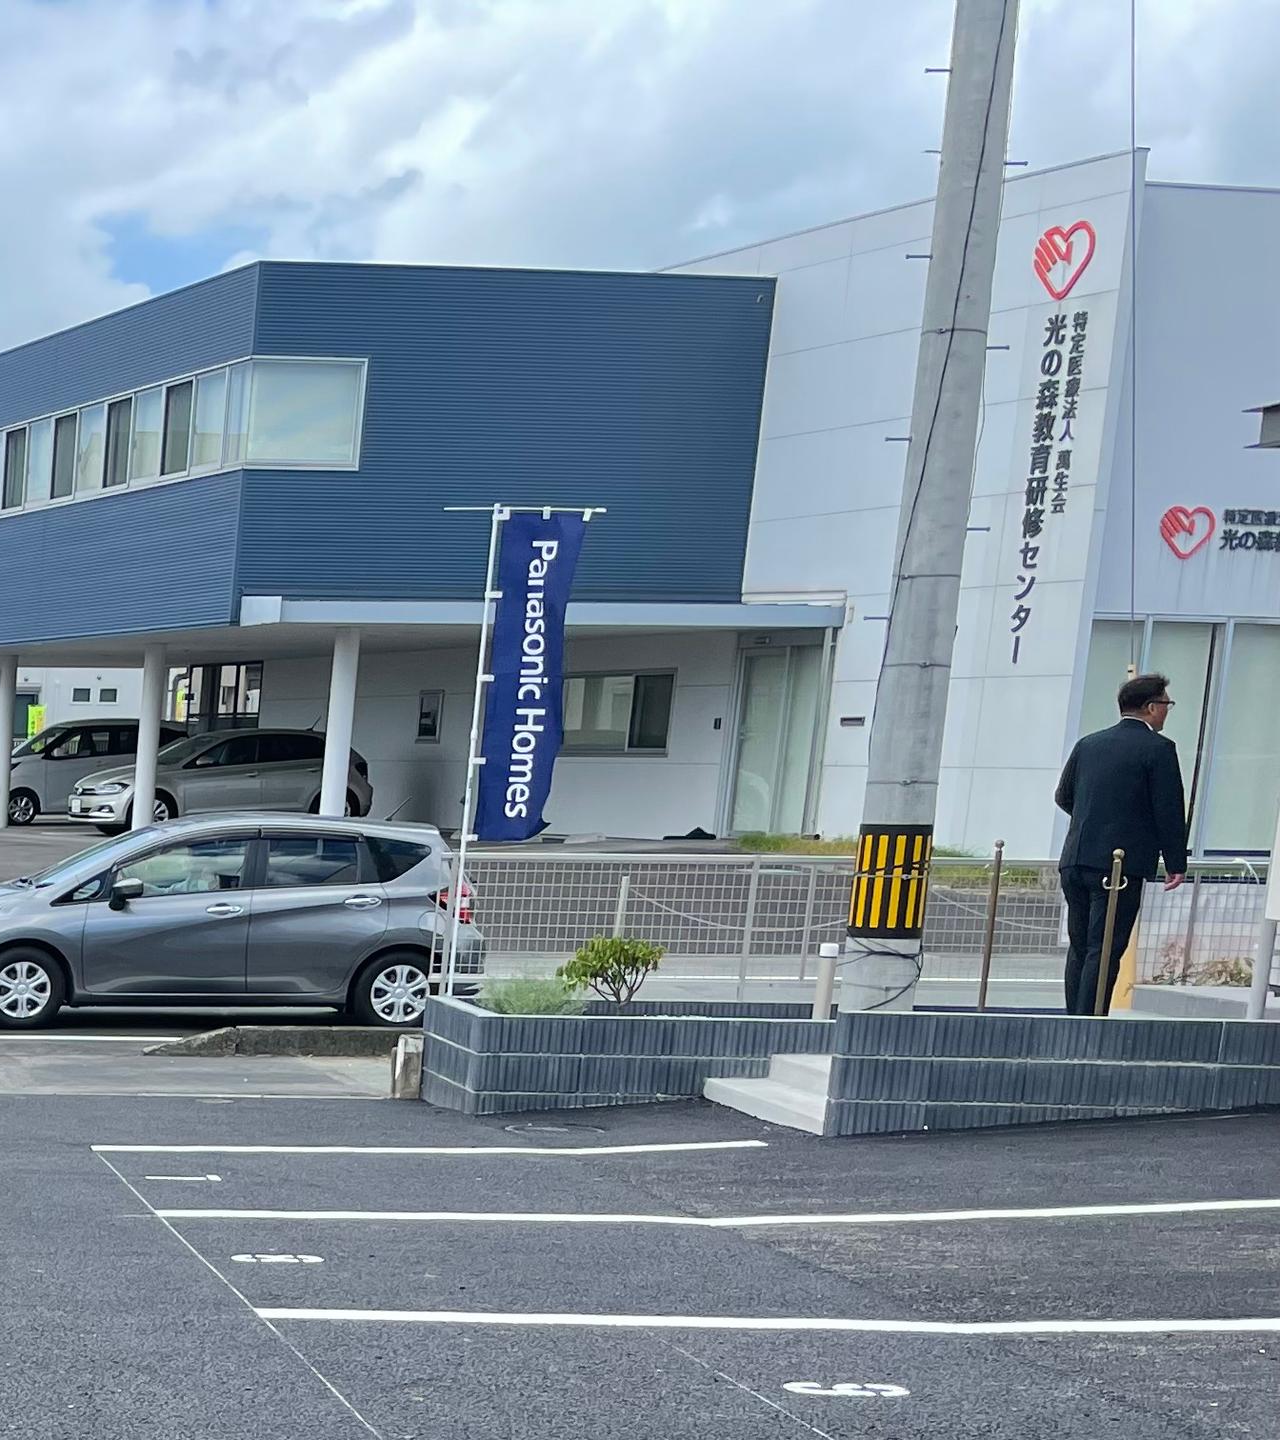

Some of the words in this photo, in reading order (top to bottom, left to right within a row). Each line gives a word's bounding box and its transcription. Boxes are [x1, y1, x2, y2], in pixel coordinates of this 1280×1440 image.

[1010, 314, 1068, 664] 光の森教育研修センター
[517, 540, 559, 700] Panasonic
[504, 708, 546, 819] Homes
